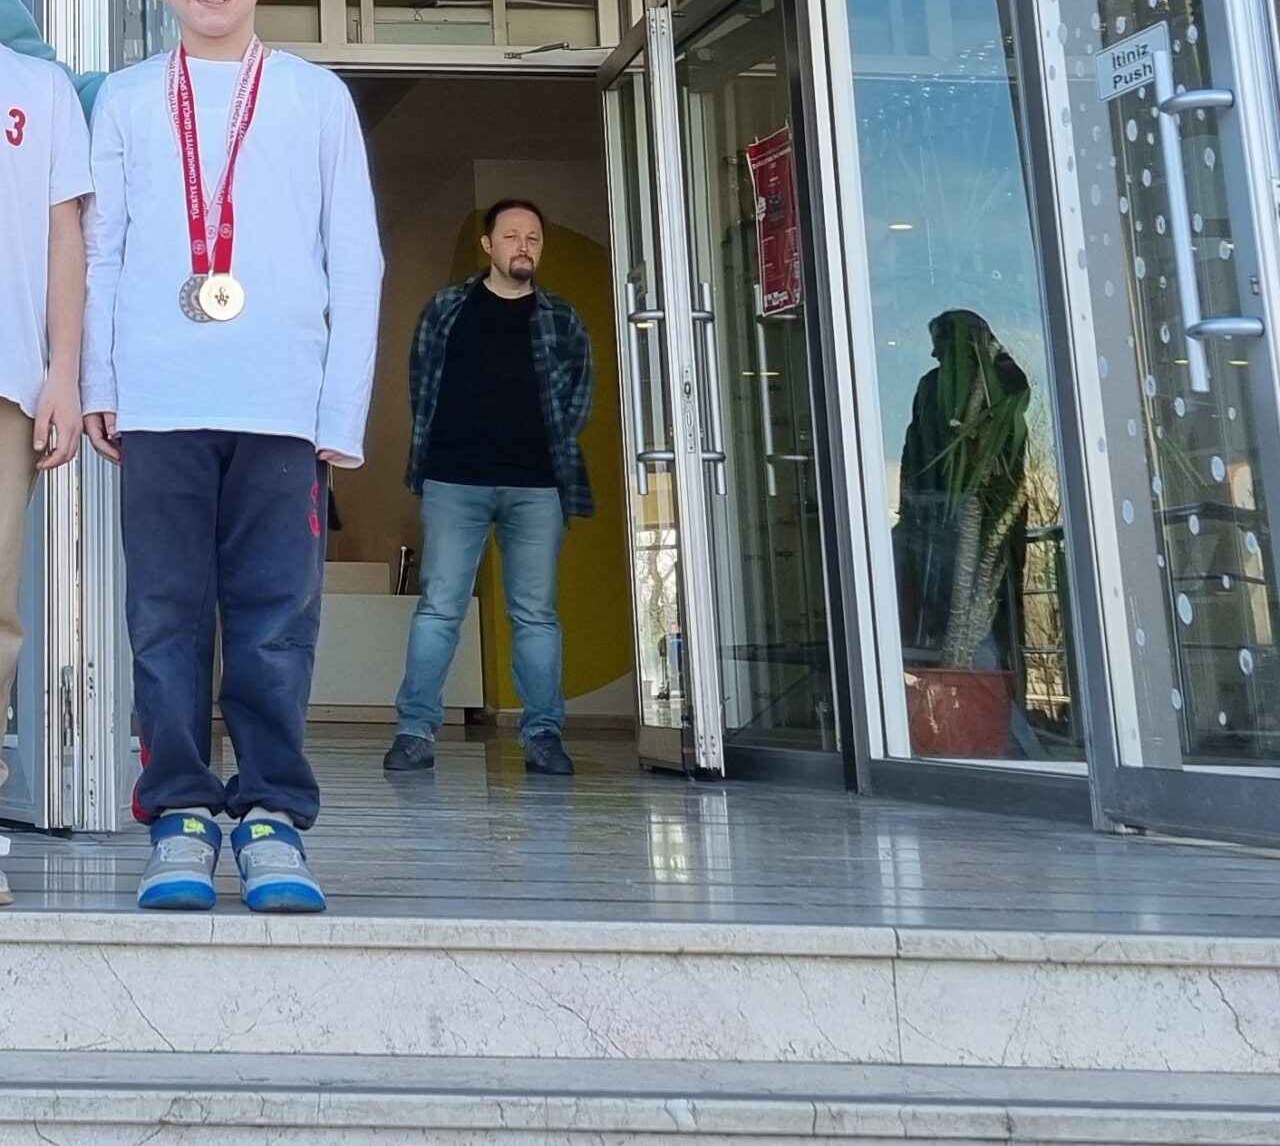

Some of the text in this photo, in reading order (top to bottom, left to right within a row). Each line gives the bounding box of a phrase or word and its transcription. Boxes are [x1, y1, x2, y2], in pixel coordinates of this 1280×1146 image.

[1113, 63, 1152, 89] Push
[5, 108, 26, 147] 3
[185, 131, 196, 184] CUMHURİYETİ
[190, 185, 200, 219] TÜRKİYE
